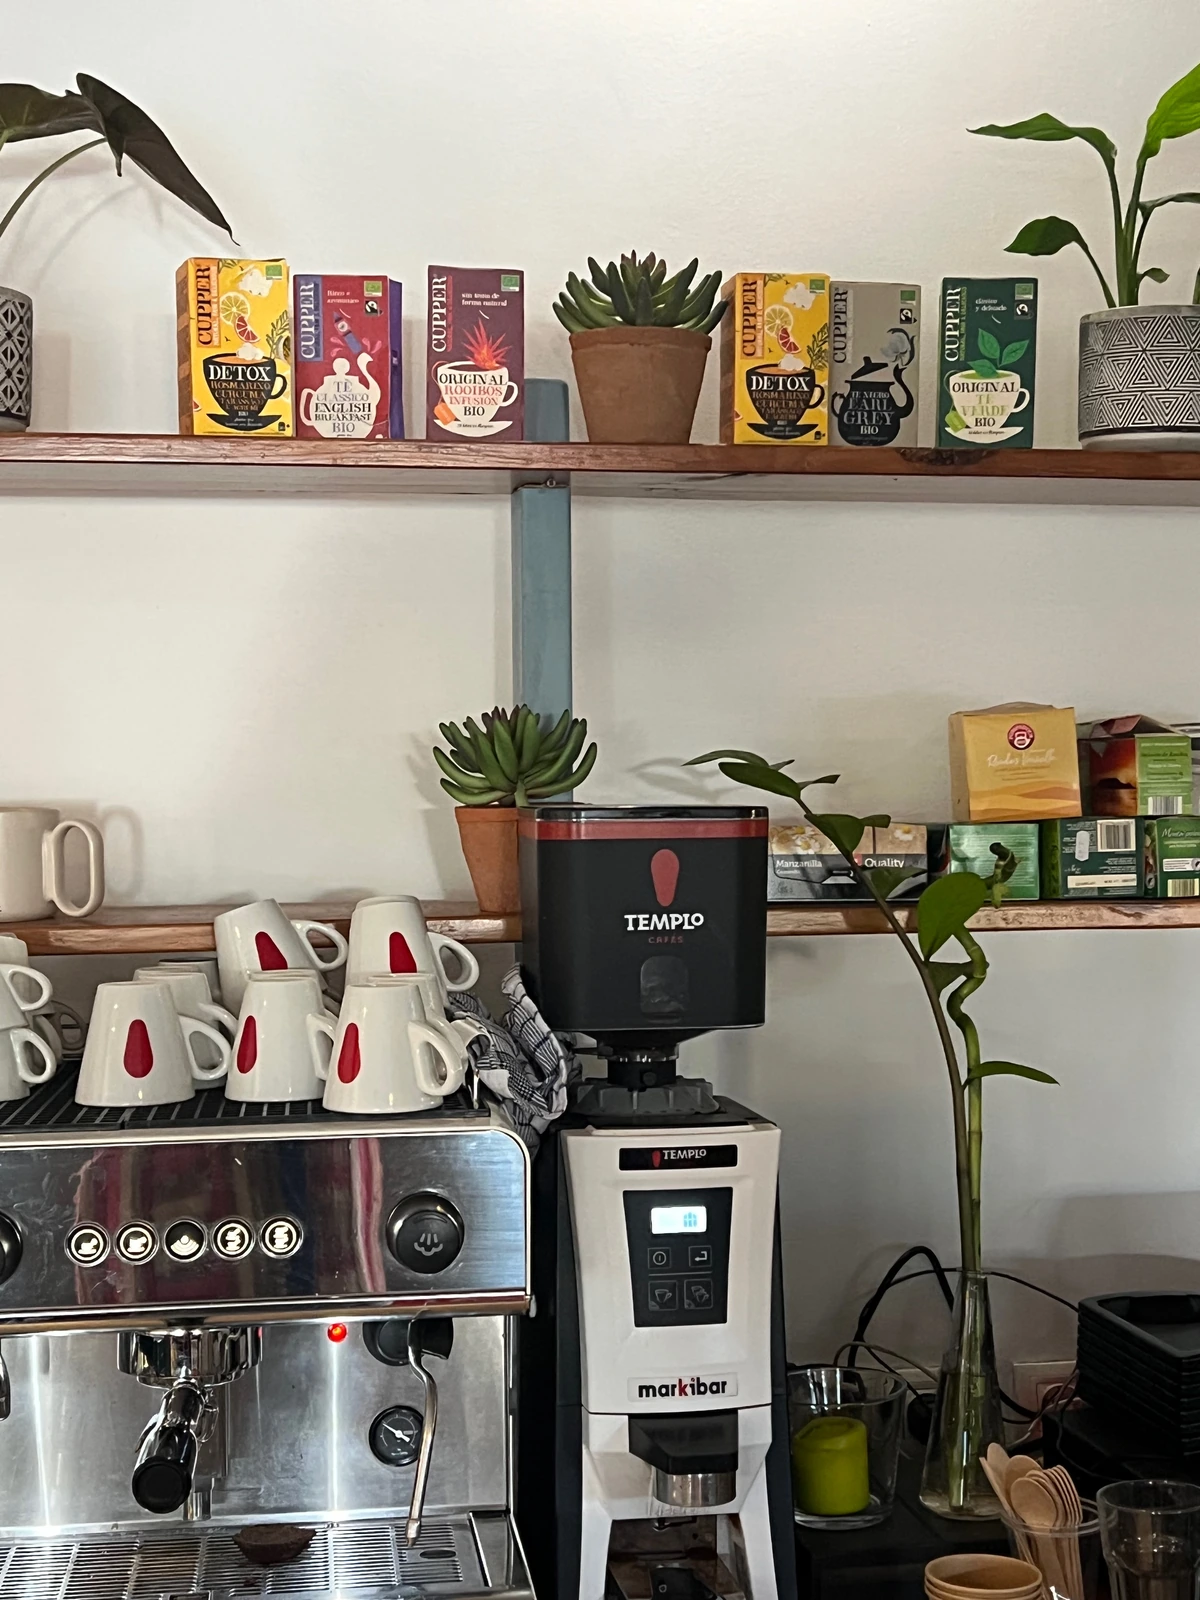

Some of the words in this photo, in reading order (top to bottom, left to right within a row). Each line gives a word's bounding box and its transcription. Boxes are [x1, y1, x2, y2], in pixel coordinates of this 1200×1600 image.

[196, 265, 213, 346] CUPPER
[300, 283, 316, 359] CUPPER
[432, 276, 447, 353] CUPPER
[742, 280, 757, 357] CUPPER
[833, 289, 848, 363] CUPPER
[944, 287, 961, 362] CUPPER
[208, 365, 271, 382] DETOX
[439, 373, 508, 386] ORIGINAL
[750, 375, 811, 392] DETOX
[952, 381, 1020, 393] ORIGINAL
[444, 385, 503, 396] ROOIBOS
[315, 402, 371, 413] ENGLISH
[848, 397, 892, 411] EARL
[314, 413, 371, 422] BREAKFAST
[463, 406, 485, 417] BIO
[960, 405, 1009, 417] VERDE
[843, 410, 895, 426] GREY
[974, 417, 996, 427] BIO
[332, 422, 355, 433] BIO
[860, 425, 879, 435] BIO
[775, 859, 823, 868] Manzanilla
[864, 857, 905, 868] Quality
[624, 912, 704, 931] TEMPLO
[662, 1148, 707, 1160] TEMPLO
[638, 1376, 727, 1398] markibar
